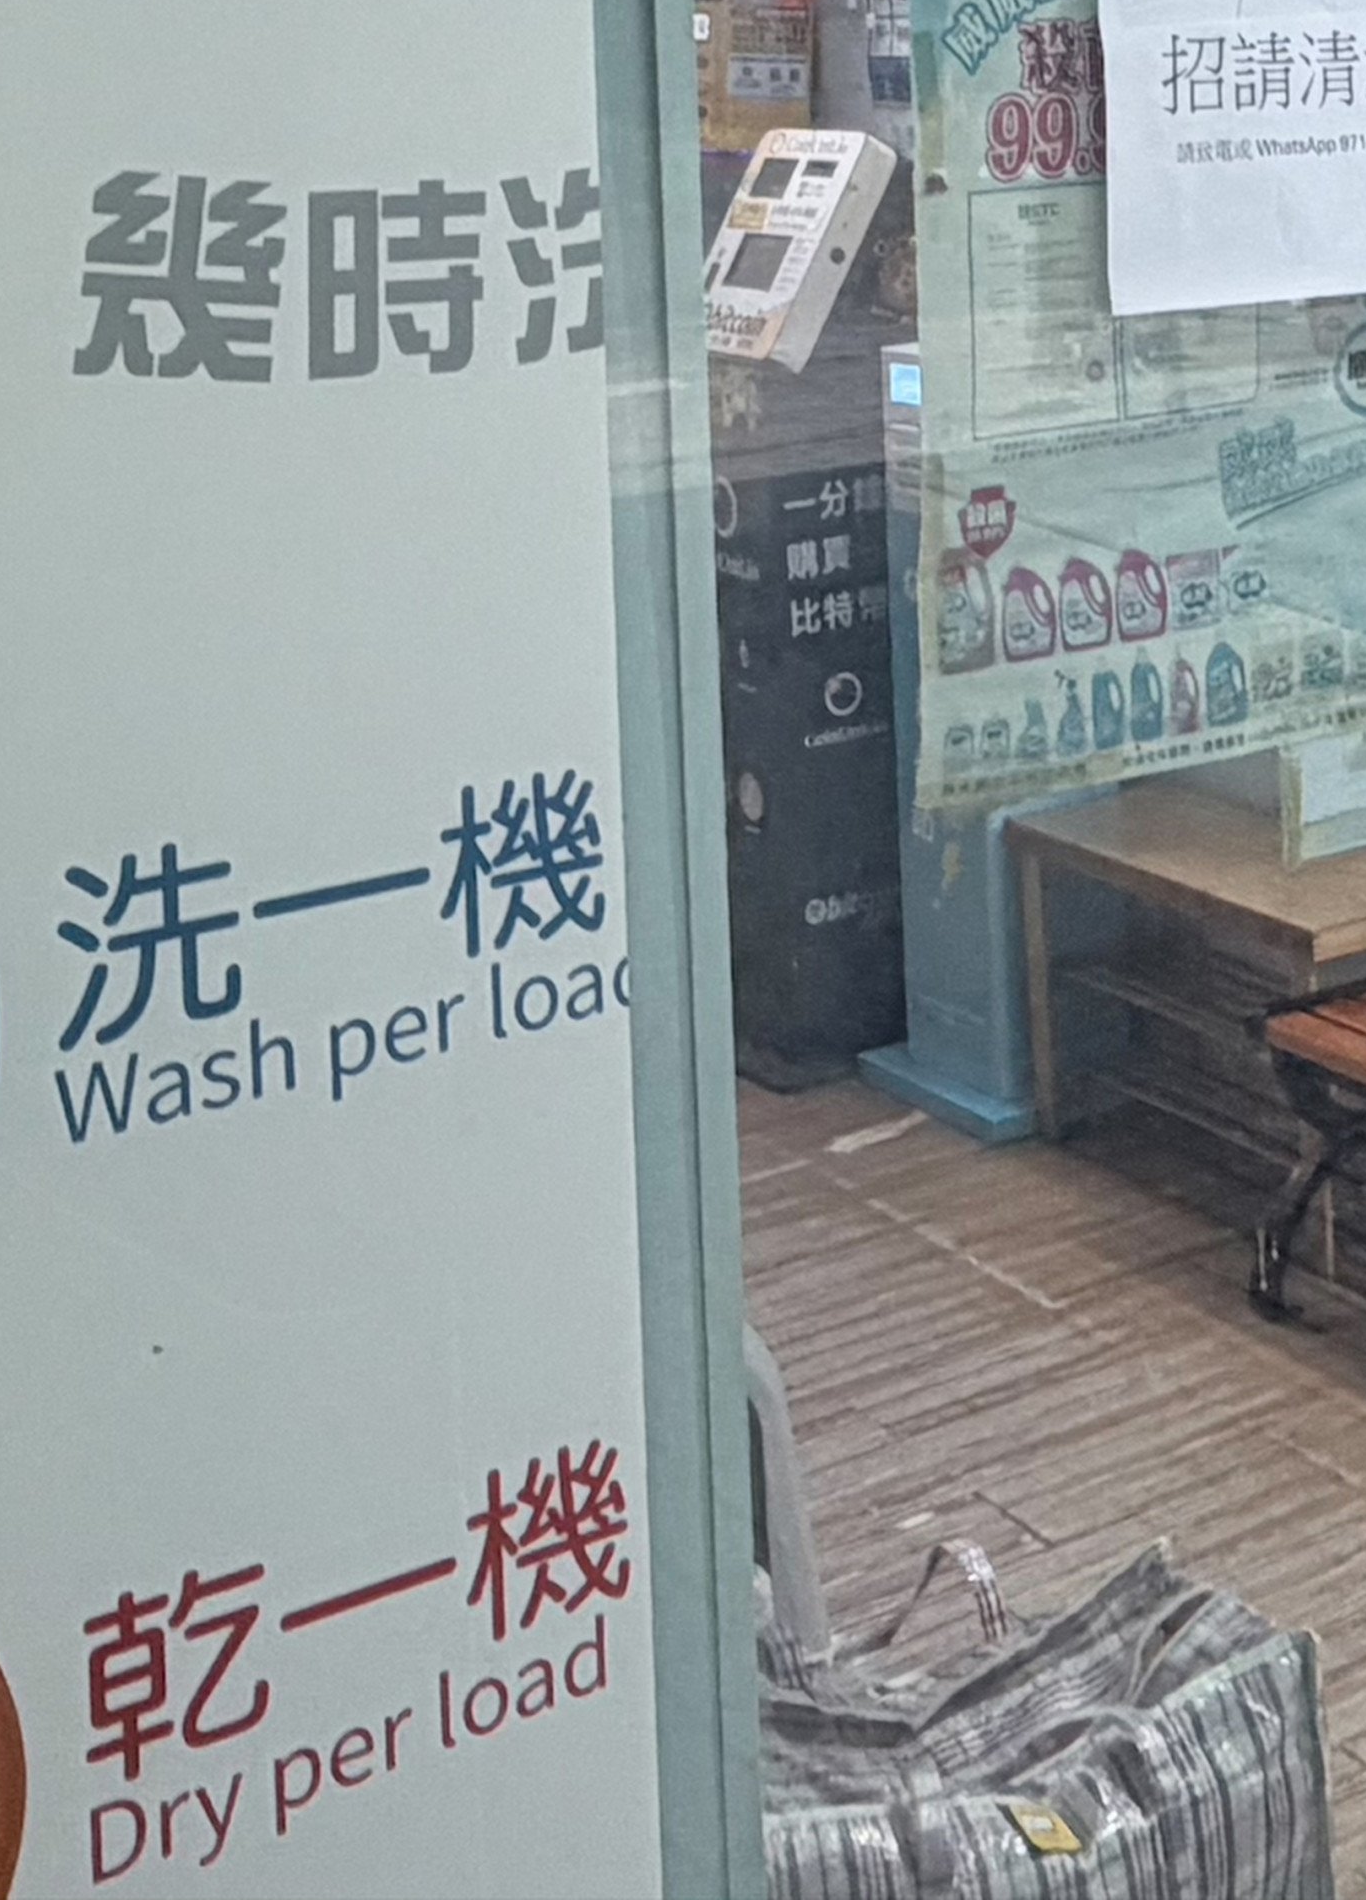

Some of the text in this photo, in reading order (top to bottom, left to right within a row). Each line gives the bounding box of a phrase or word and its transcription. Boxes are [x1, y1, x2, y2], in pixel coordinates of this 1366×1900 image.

[1256, 136, 1338, 157] WhatsApp
[57, 769, 605, 1052] 洗一機
[54, 1017, 296, 1143] Wash
[329, 993, 466, 1102] per
[82, 1439, 631, 1782] 乾一機
[89, 1612, 609, 1885] Dry per load
